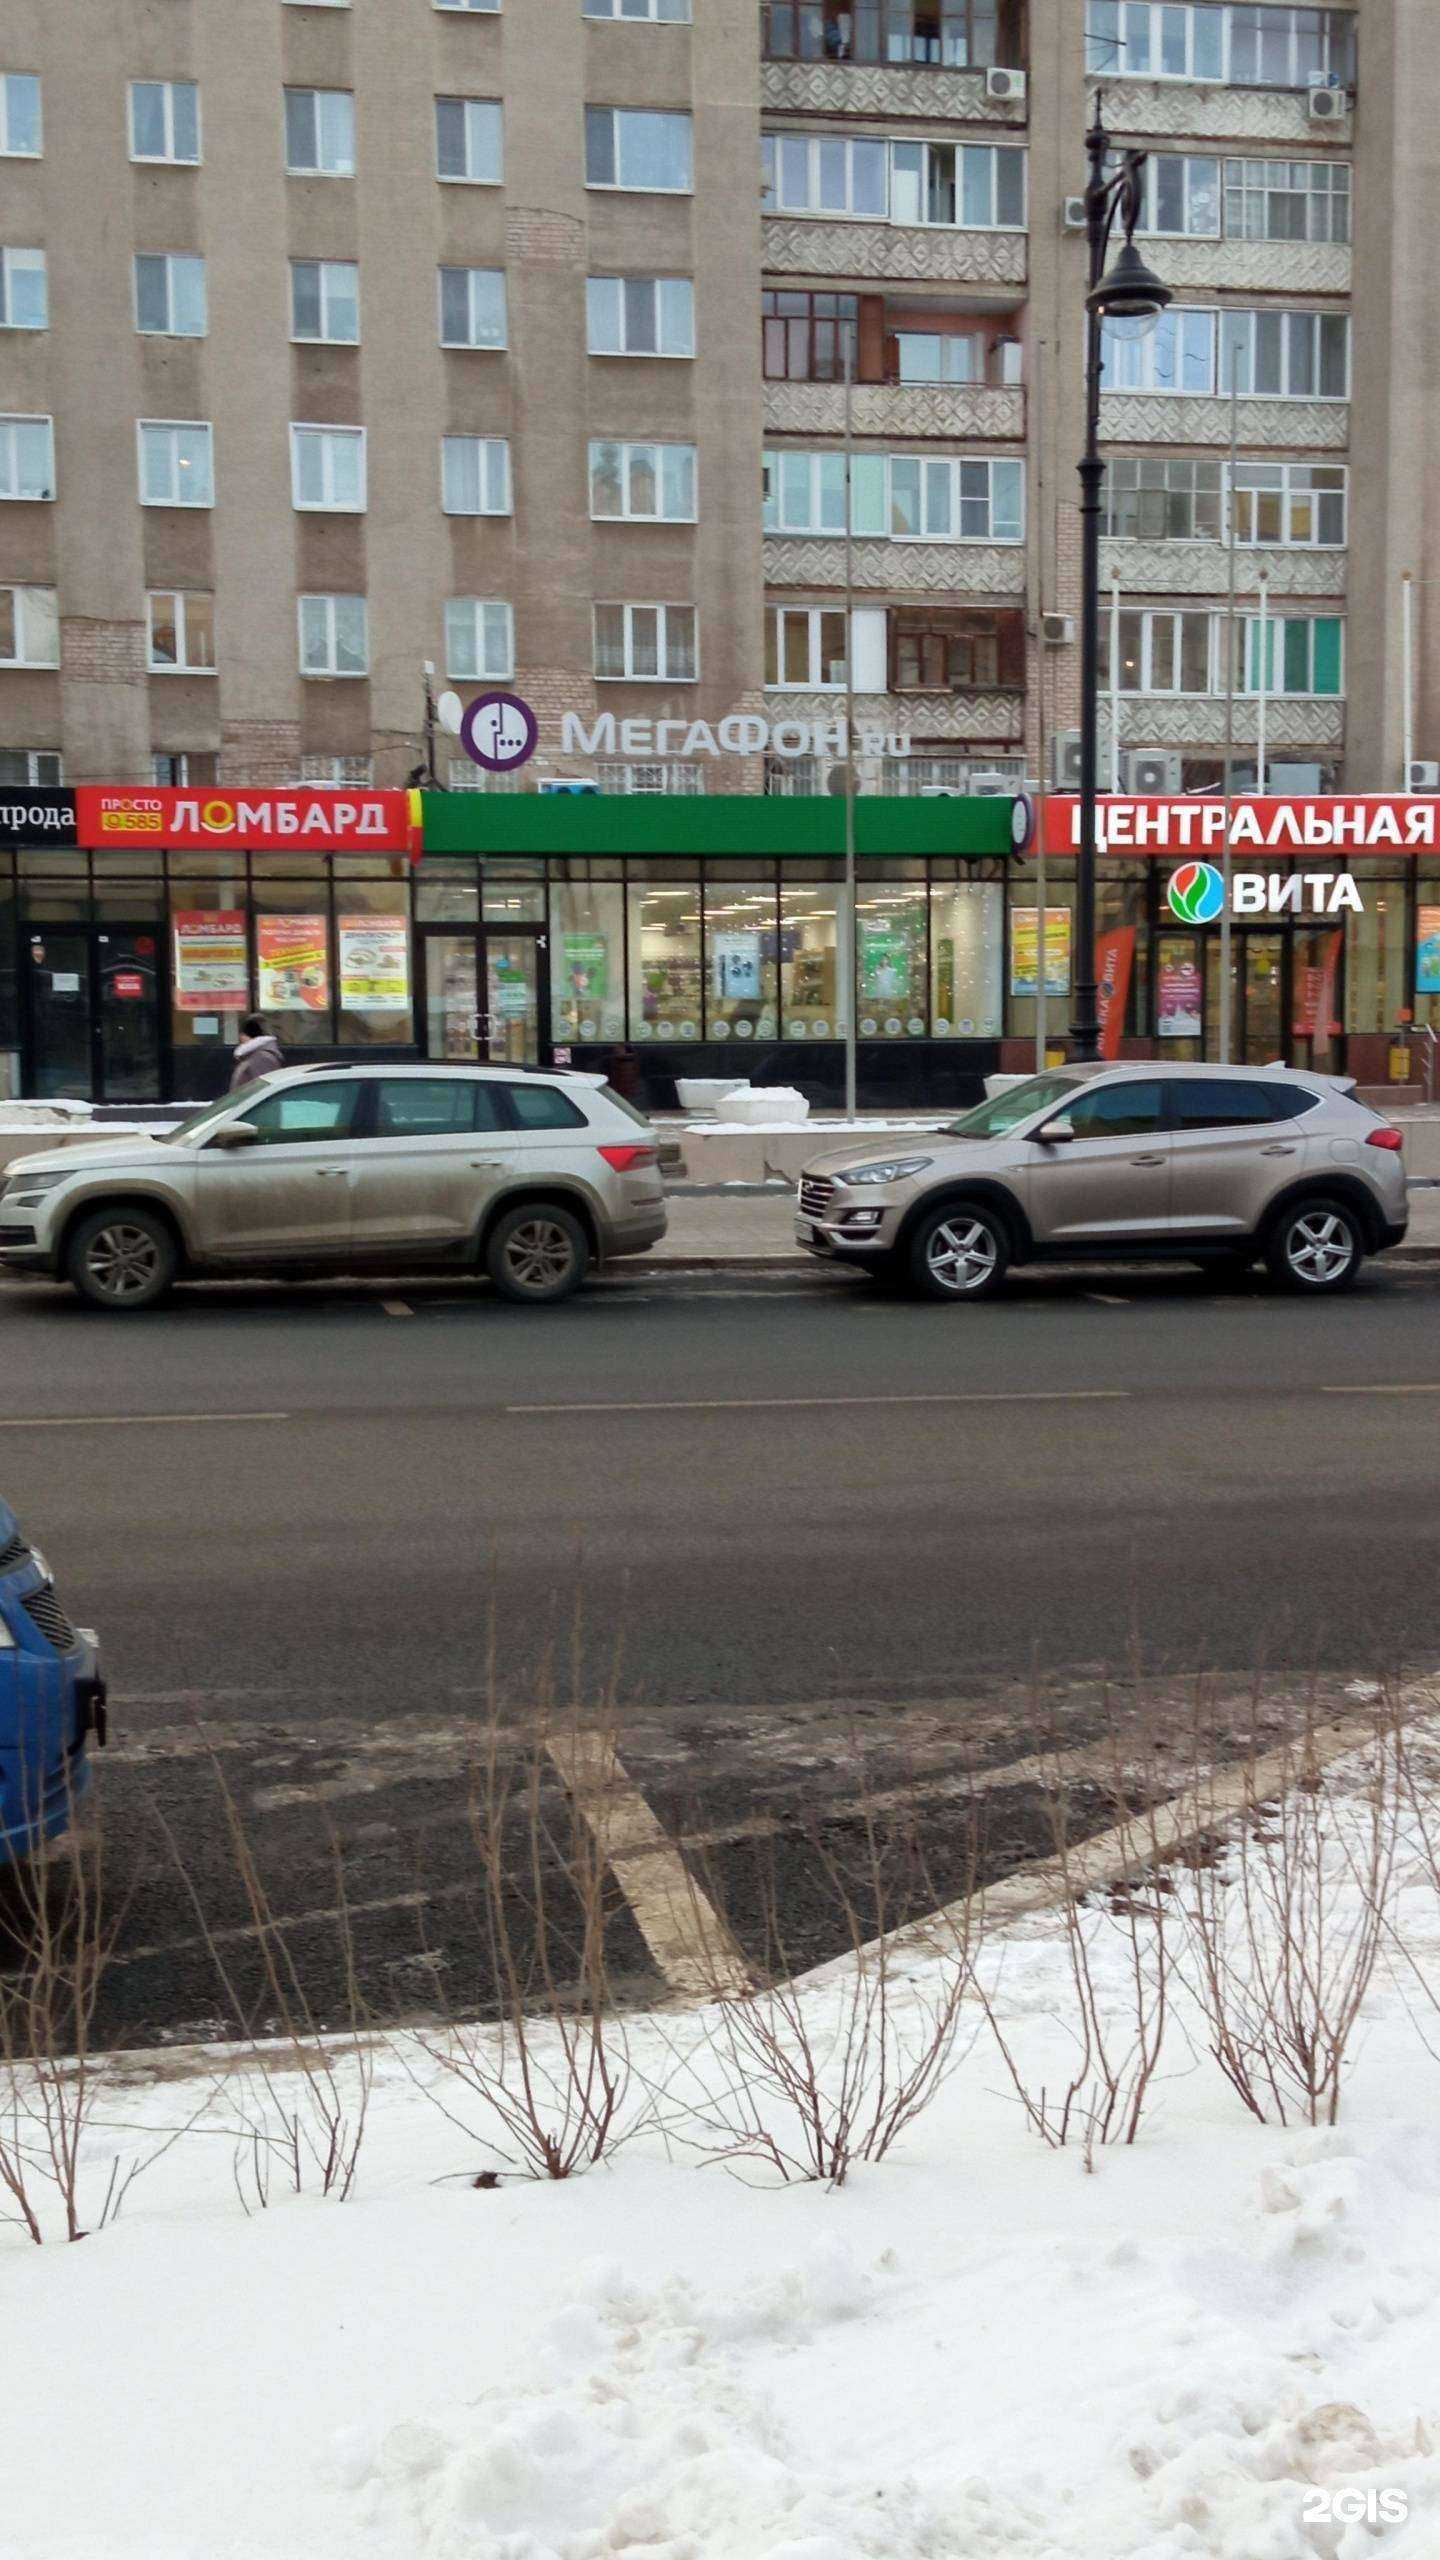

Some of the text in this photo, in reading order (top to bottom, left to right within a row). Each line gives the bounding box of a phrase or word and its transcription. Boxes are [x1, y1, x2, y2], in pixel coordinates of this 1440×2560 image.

[101, 798, 162, 811] ПРОСТО
[170, 800, 388, 834] ЛОМБАРД
[1071, 804, 1435, 853] ЦЕНТРАЛЬНАЯ
[1232, 873, 1365, 913] ВИТА
